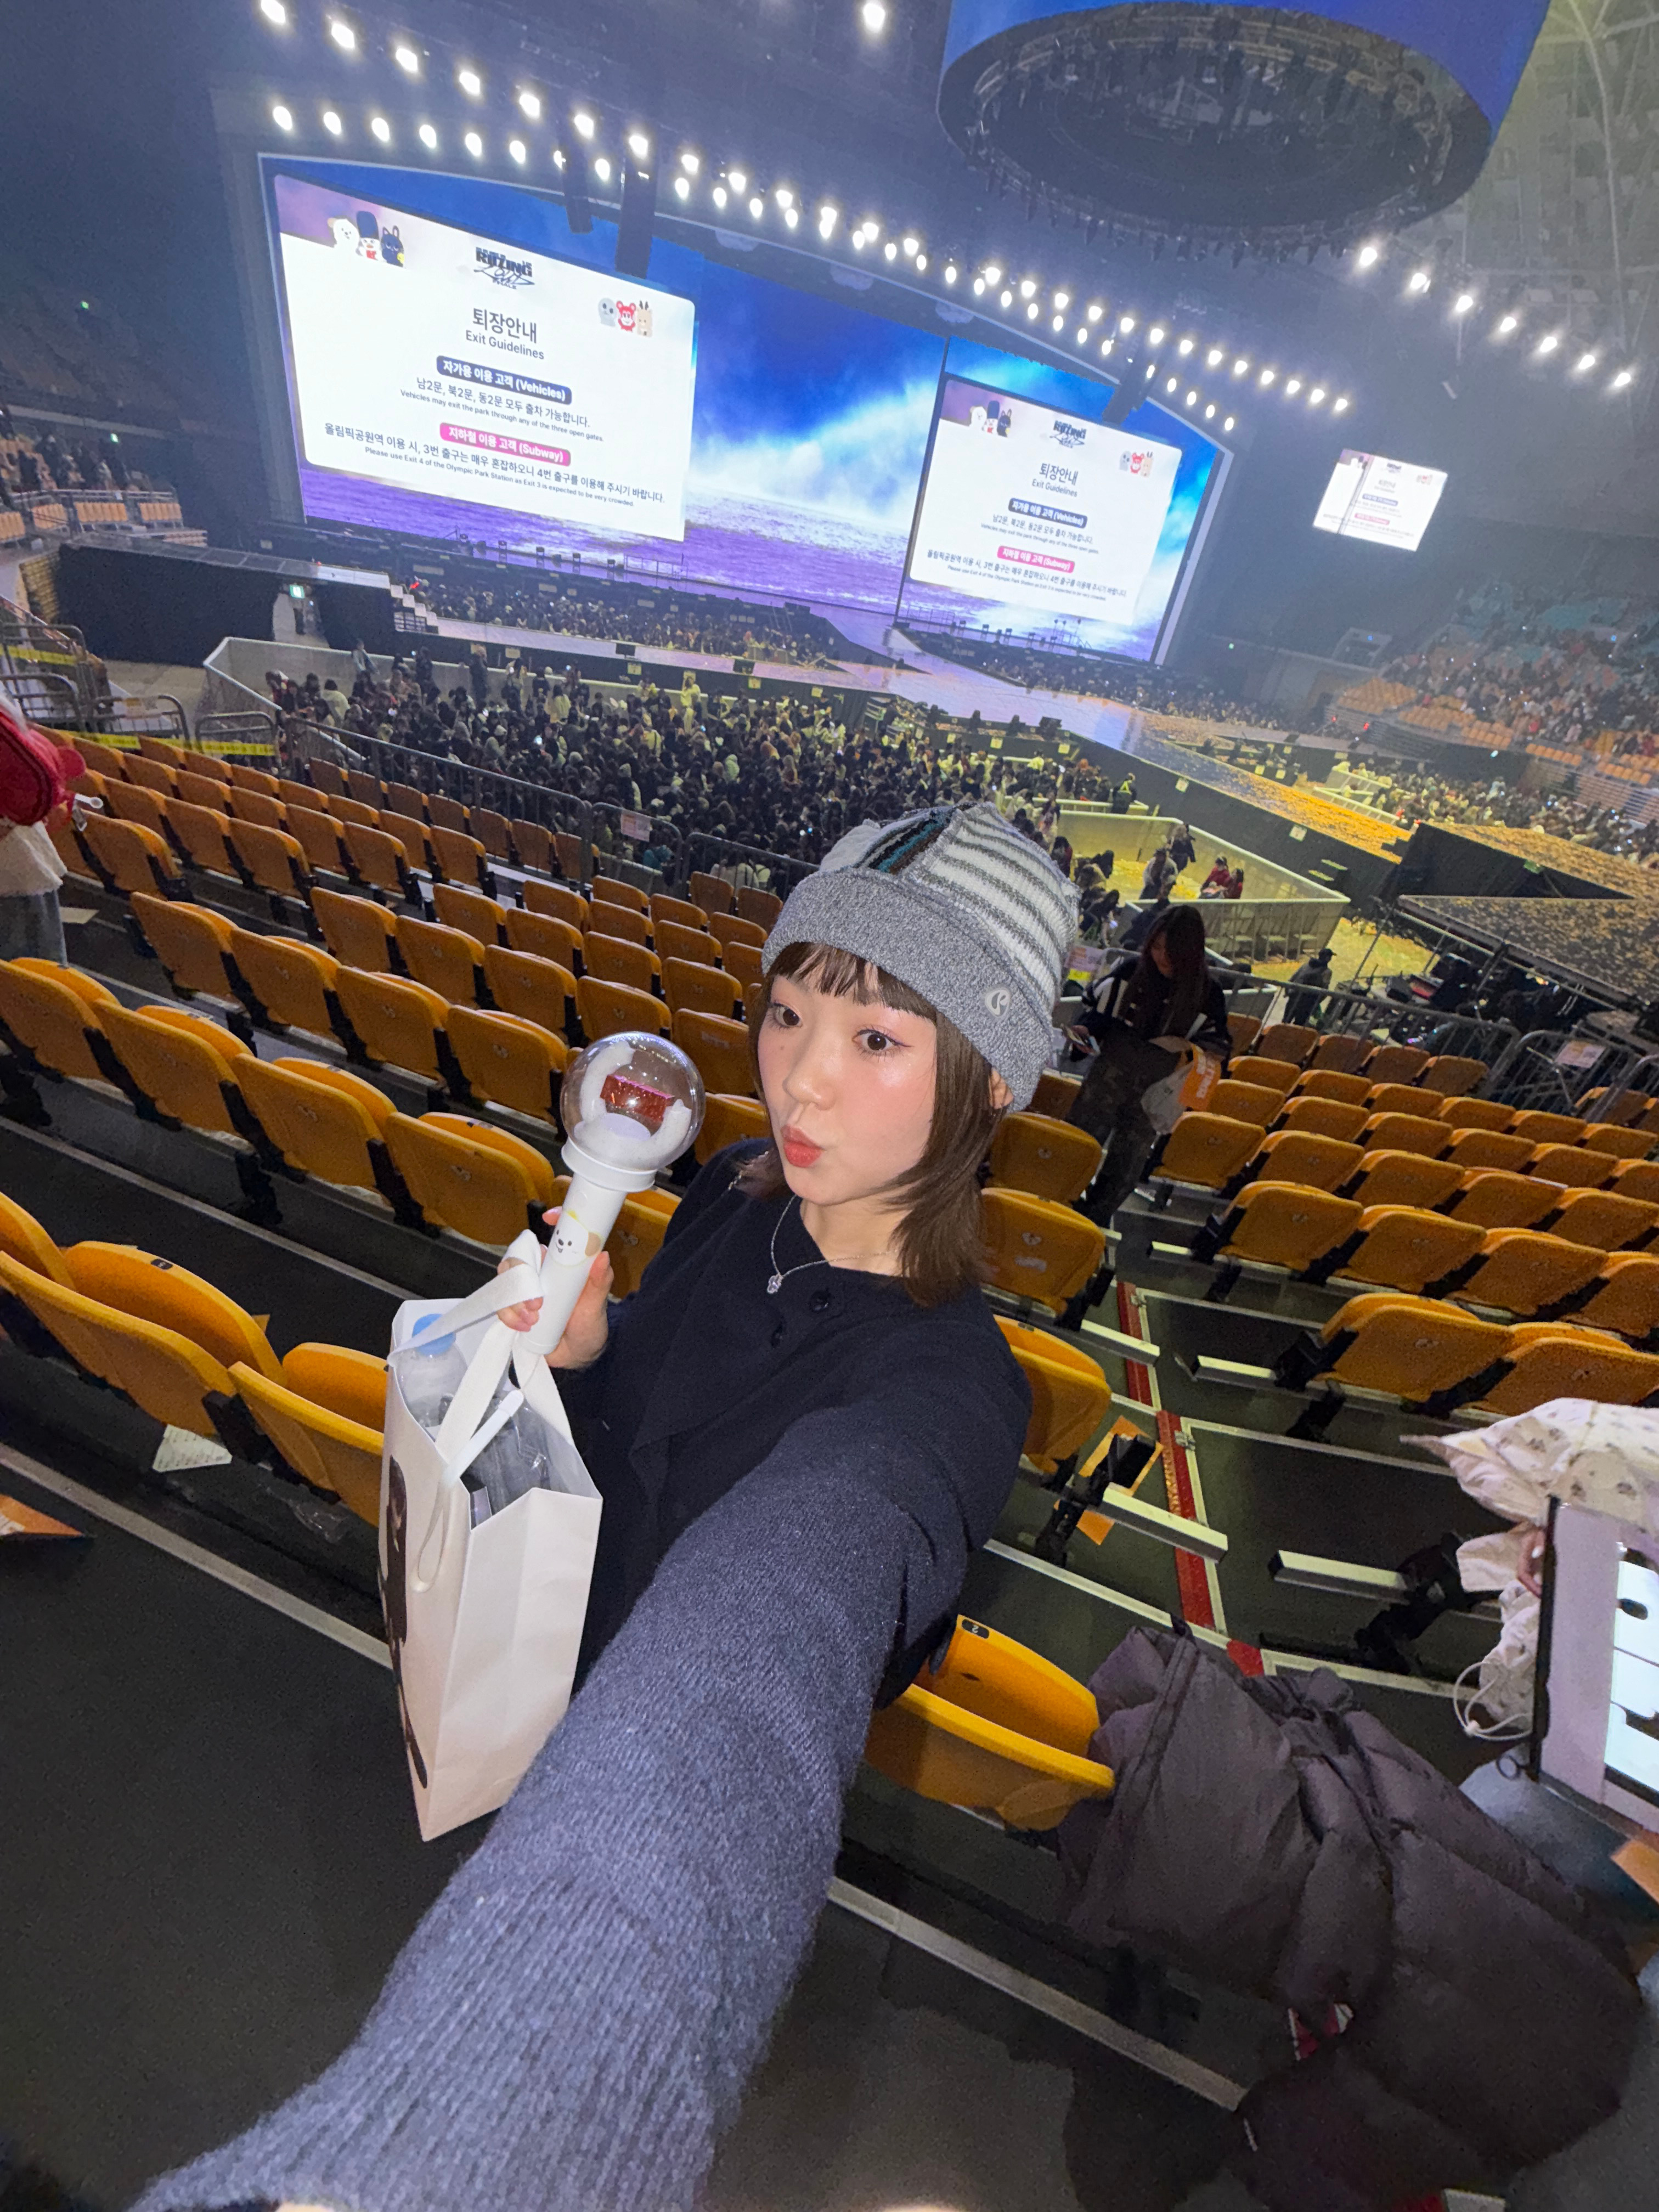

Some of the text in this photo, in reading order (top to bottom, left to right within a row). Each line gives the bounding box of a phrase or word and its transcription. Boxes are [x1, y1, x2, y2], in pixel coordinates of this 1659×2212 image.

[473, 309, 536, 342] 퇴장안내
[466, 330, 544, 359] Exit Guidelines
[443, 360, 565, 400] 자가용 이용 고객 (Vehicles)
[400, 390, 430, 401] Vehicles
[432, 398, 445, 407] may
[492, 411, 516, 422] through
[551, 425, 567, 433] three
[417, 377, 589, 427] 남2문, 북2문, 동2문 모두 출차 가능합니다.
[325, 423, 383, 447] 올림픽공원역
[386, 437, 405, 449] 이용
[409, 441, 420, 454] 시,
[424, 444, 438, 456] 3번
[442, 448, 467, 462] 출구는
[471, 454, 488, 466] 매우
[492, 459, 533, 476] 혼잡하오니
[537, 469, 550, 479] 4번
[554, 471, 577, 485] 출구를
[580, 477, 604, 490] 이용해
[607, 483, 629, 495] 주시기
[449, 426, 563, 461] 지하철 이용 고객 (Subway)
[365, 447, 388, 456] Please
[404, 454, 416, 462] Exit
[446, 464, 472, 473] Olympic
[491, 472, 513, 481] Station
[549, 486, 576, 494] expected
[1031, 478, 1078, 496] Exit Guidelines
[1039, 464, 1078, 484] 퇴장안내
